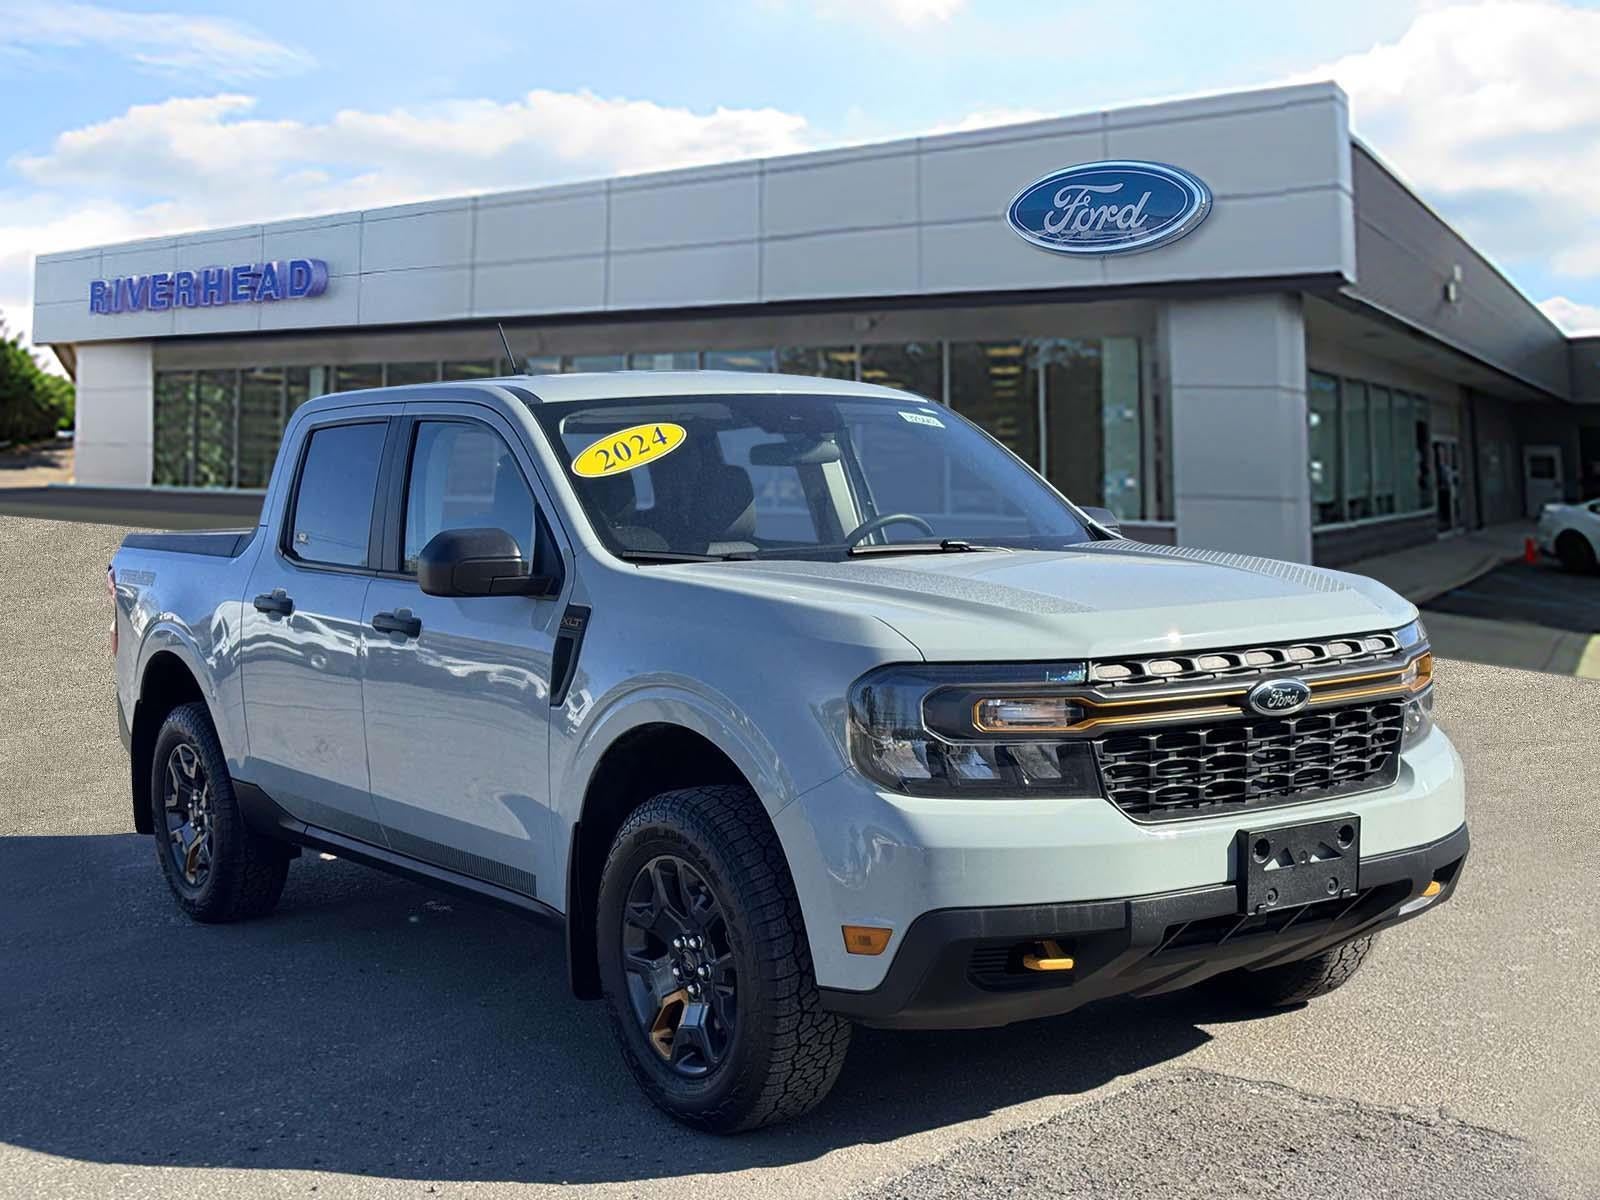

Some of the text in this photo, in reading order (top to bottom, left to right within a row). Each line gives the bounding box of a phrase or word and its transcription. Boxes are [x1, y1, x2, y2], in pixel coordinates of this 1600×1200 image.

[1044, 183, 1152, 234] Ford
[89, 259, 324, 315] RIVERHEAD
[594, 426, 668, 472] 2024
[1267, 687, 1300, 709] Ford
